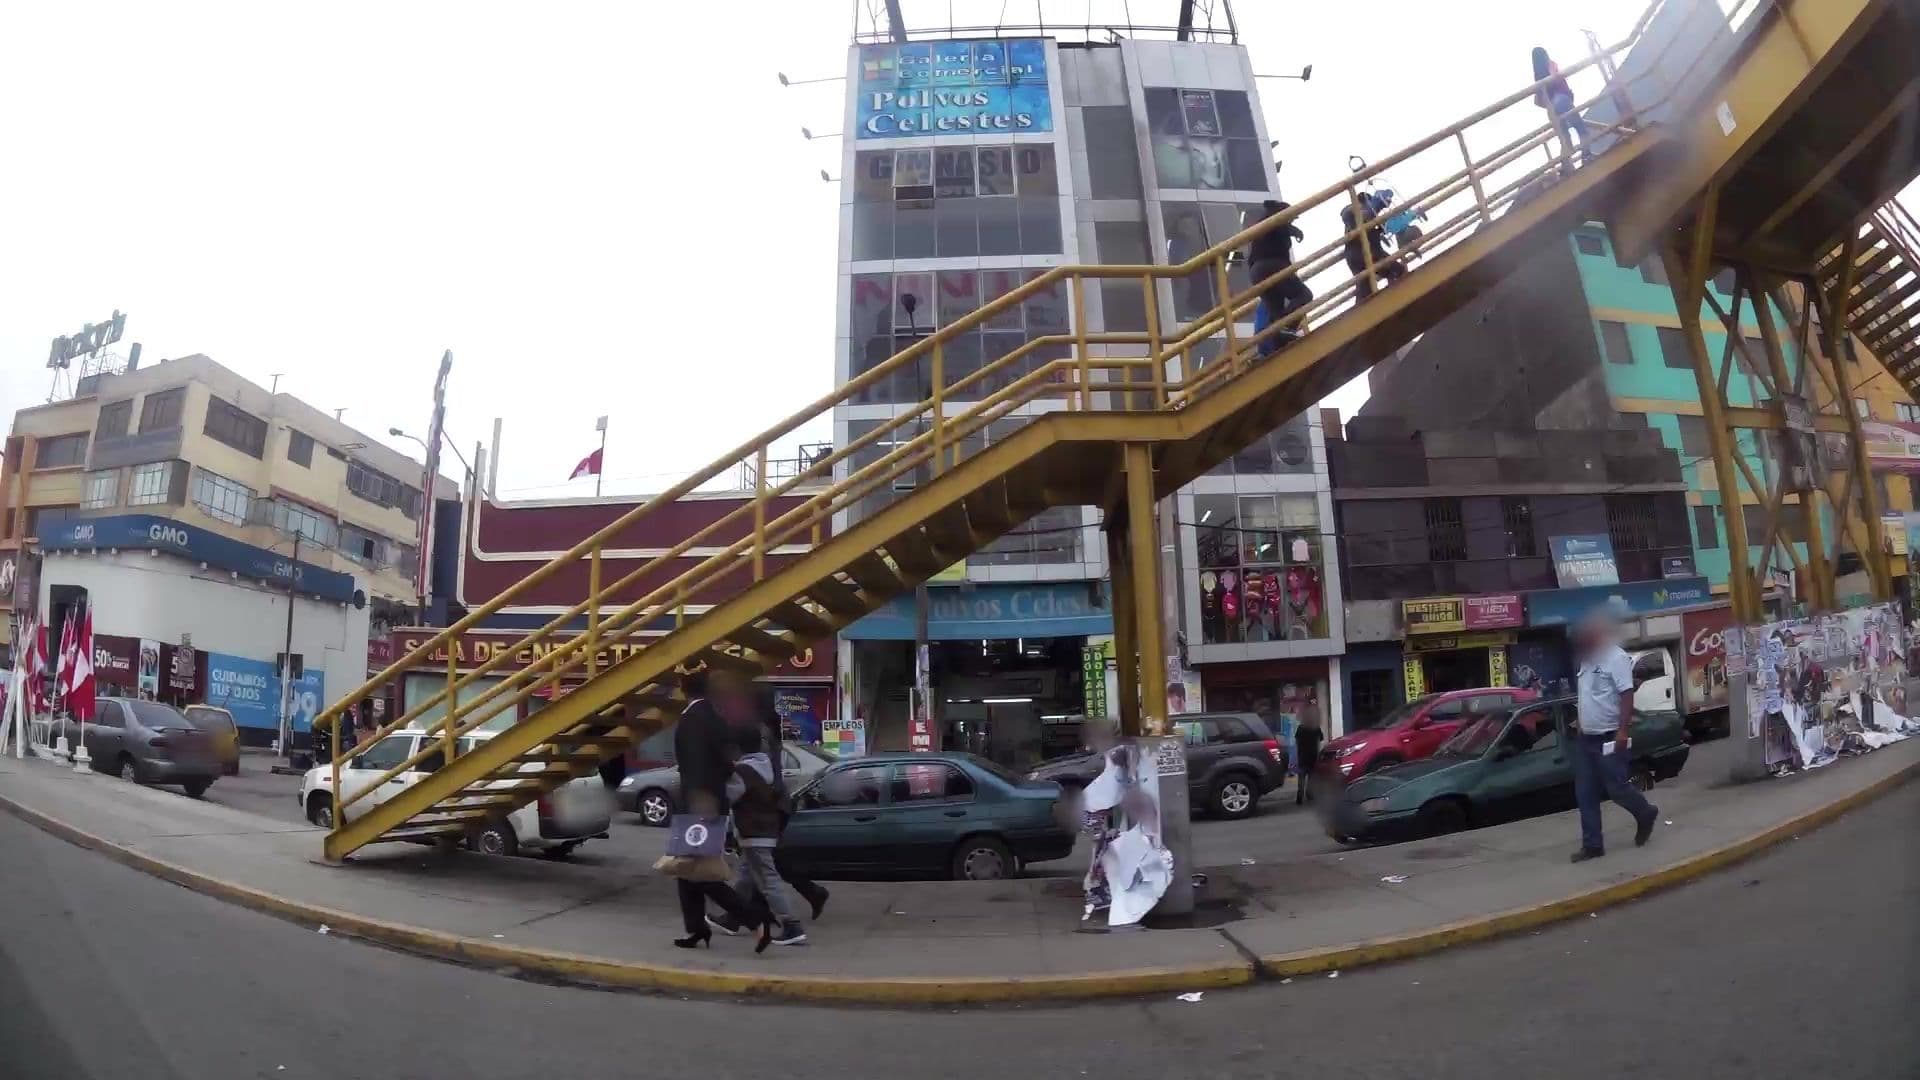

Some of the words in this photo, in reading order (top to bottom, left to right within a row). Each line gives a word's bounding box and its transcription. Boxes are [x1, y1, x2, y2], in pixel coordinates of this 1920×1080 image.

[872, 88, 990, 111] Polvos
[866, 112, 1032, 134] Celestes
[74, 525, 95, 540] GMO
[149, 524, 188, 546] GMO
[912, 719, 931, 751] EM
